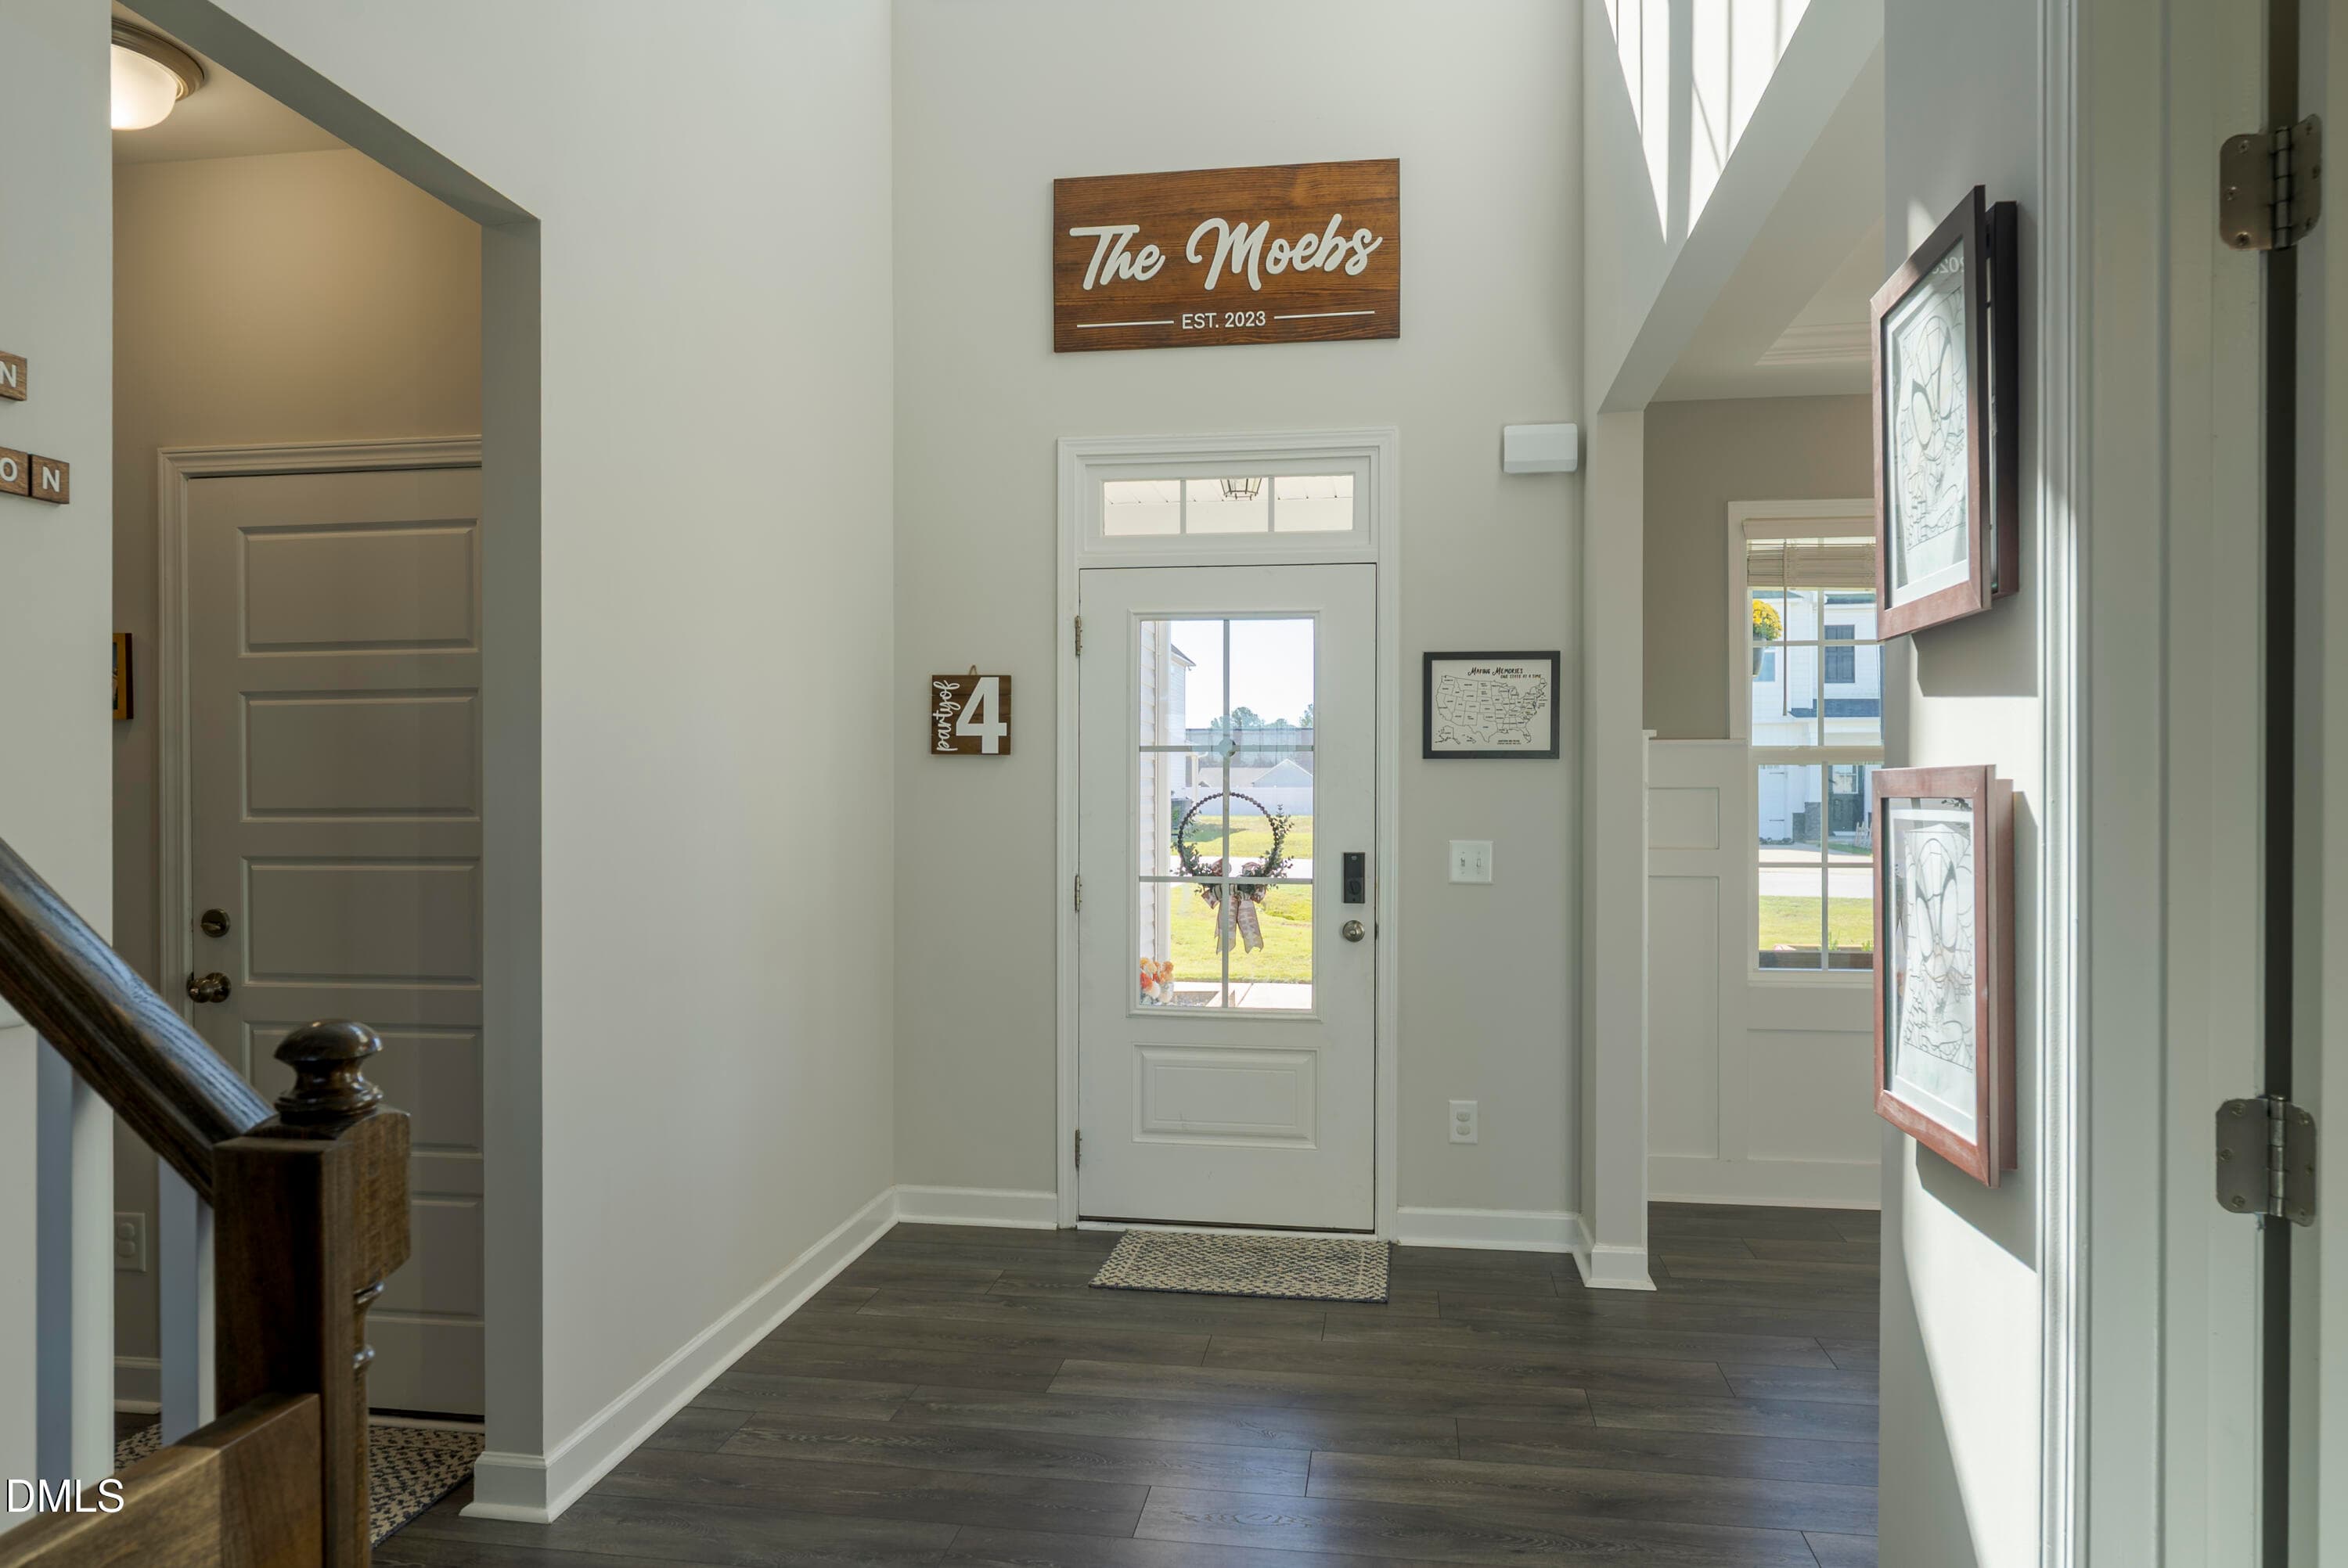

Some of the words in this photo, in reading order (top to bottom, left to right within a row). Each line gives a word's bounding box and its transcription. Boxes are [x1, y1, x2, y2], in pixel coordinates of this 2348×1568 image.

[1069, 224, 1165, 290] The
[1186, 213, 1383, 290] Moebs
[1182, 313, 1219, 329] EST.
[1225, 311, 1266, 328] 2023
[1493, 667, 1523, 675] MEMORIES
[956, 677, 1007, 753] 4
